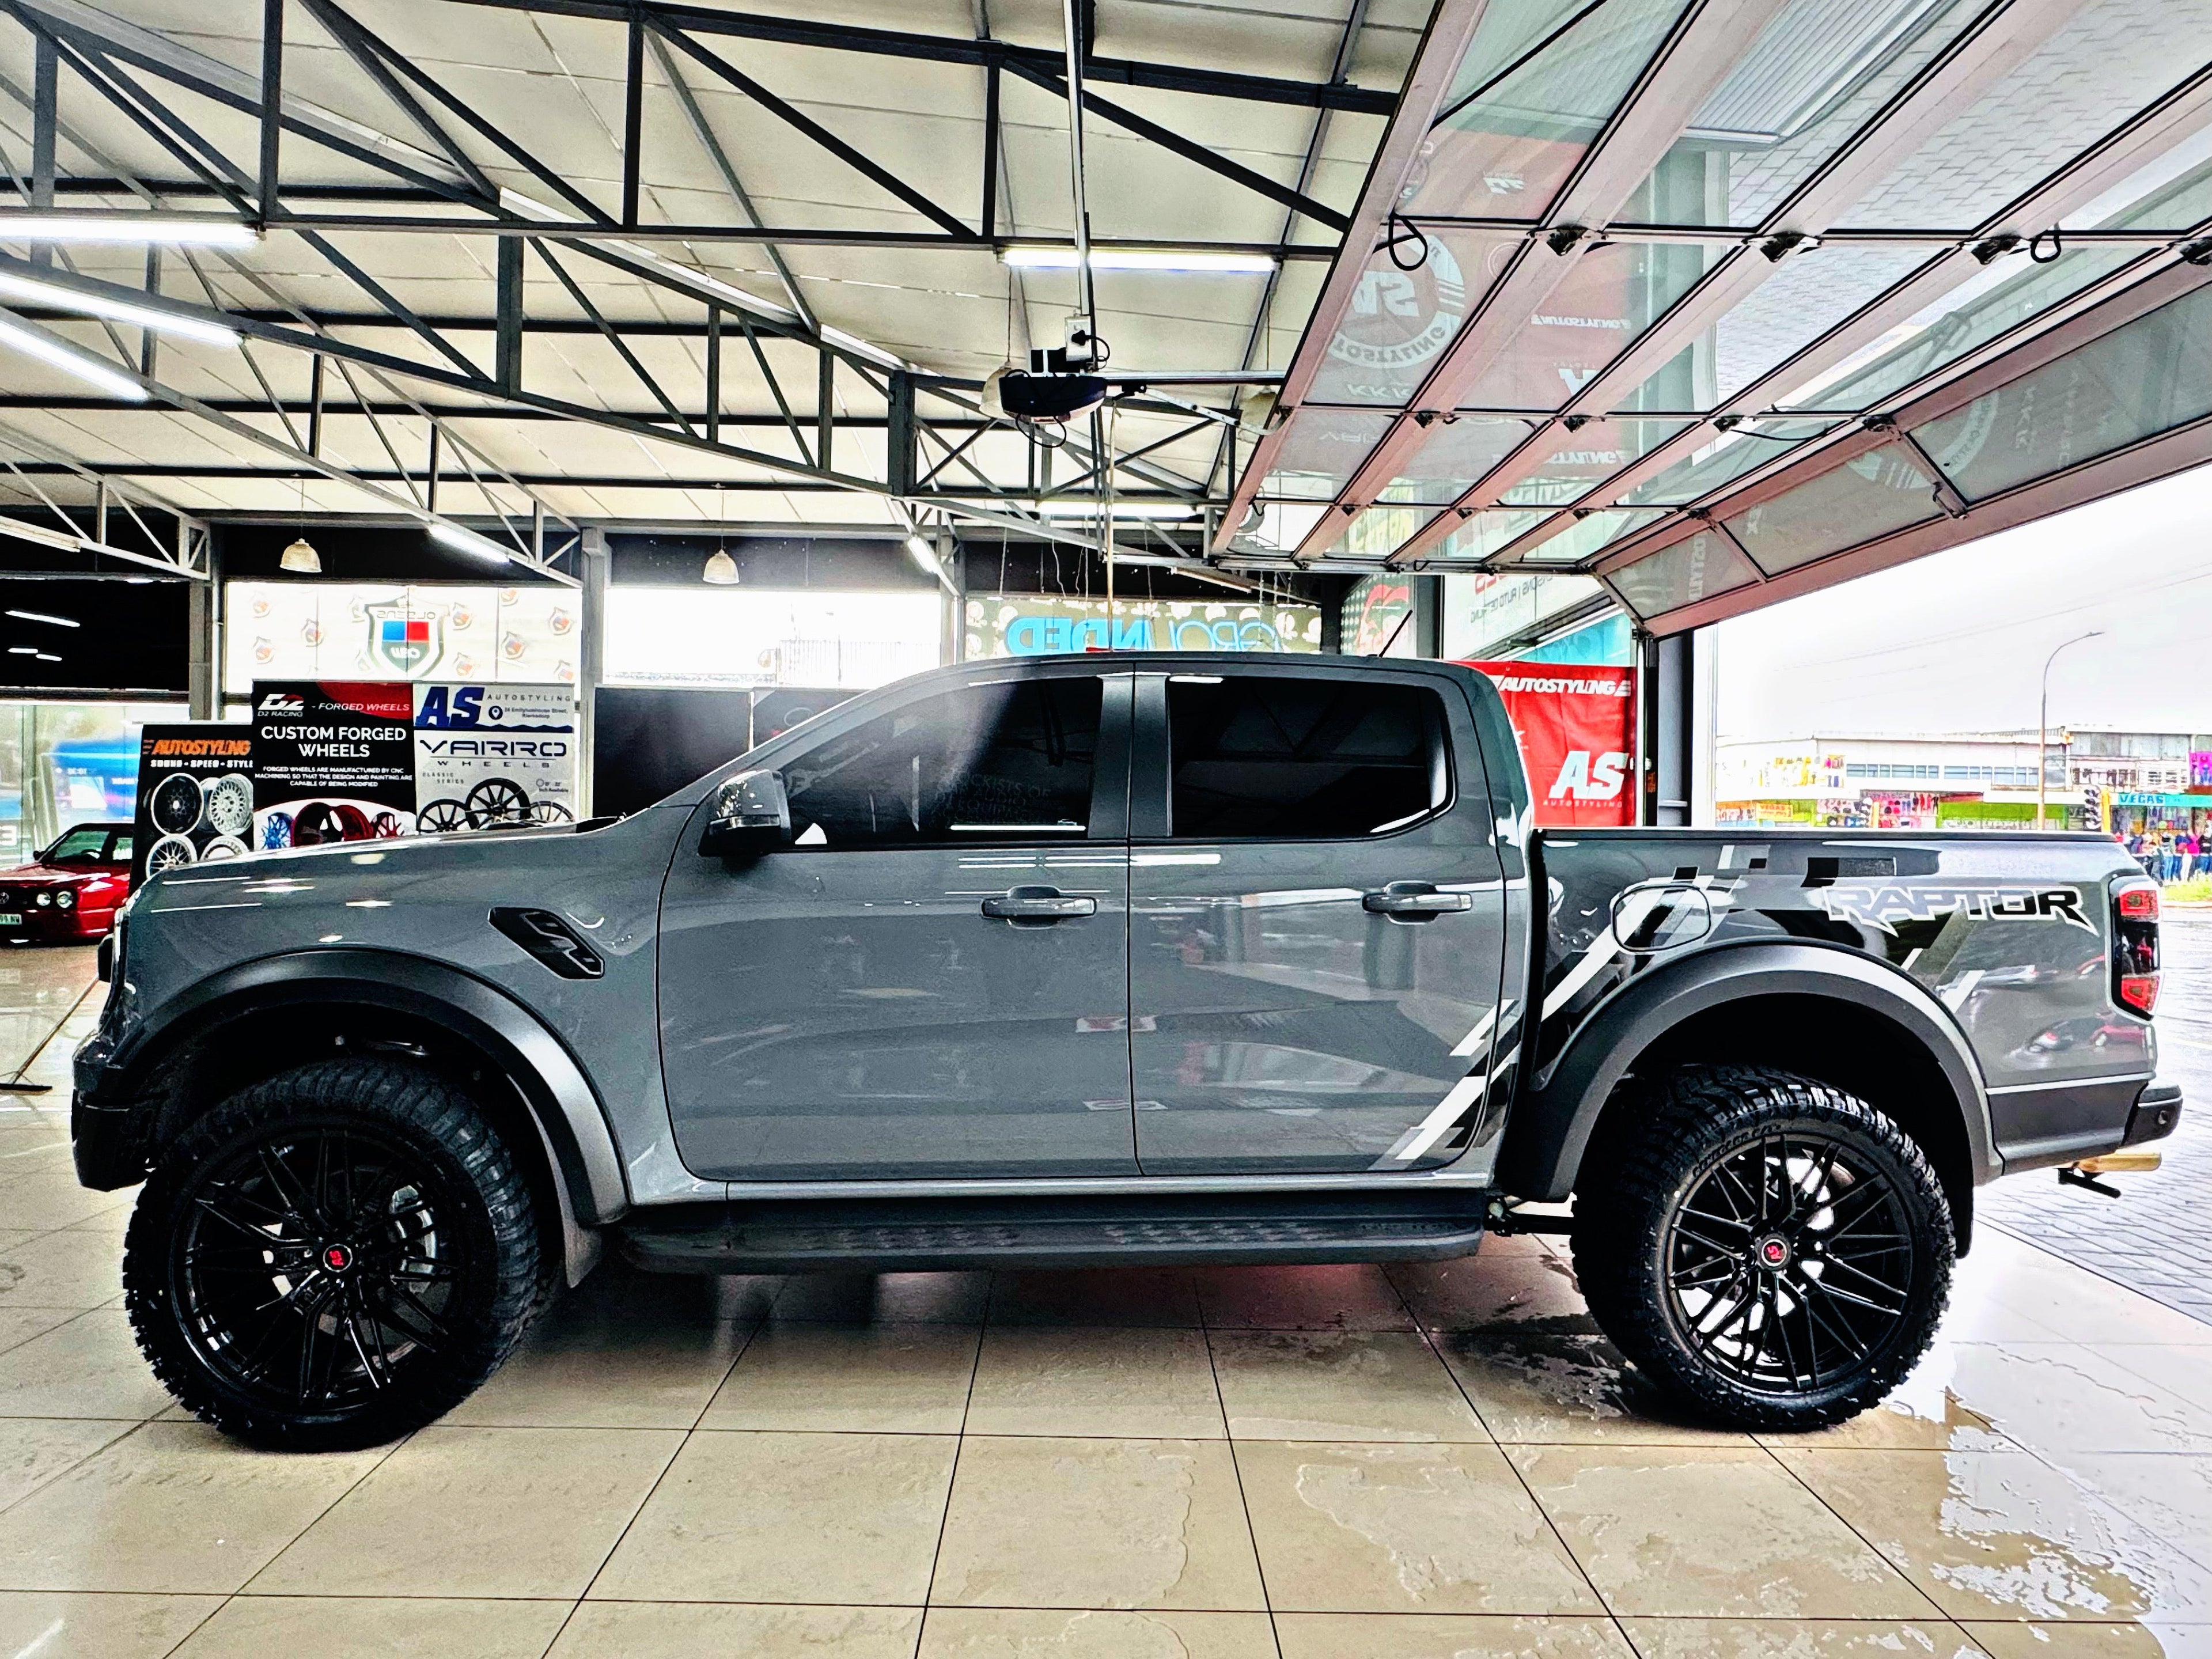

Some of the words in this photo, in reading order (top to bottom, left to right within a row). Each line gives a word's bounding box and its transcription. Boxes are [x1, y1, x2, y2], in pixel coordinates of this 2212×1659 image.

[1498, 677, 1616, 695] AUTOSTYLING
[257, 694, 304, 710] D2
[318, 703, 363, 711] FORGED
[366, 703, 410, 711] WHEELS
[415, 686, 485, 727] AS
[261, 726, 334, 740] CUSTOM
[338, 727, 406, 741] FORGED
[151, 740, 251, 756] AUTOSTYLING
[298, 744, 370, 757] WHEELS
[419, 740, 567, 757] VARRO
[226, 760, 253, 768] STYLE
[1548, 751, 1629, 800] AS
[1822, 886, 2100, 937] RAPTOR
